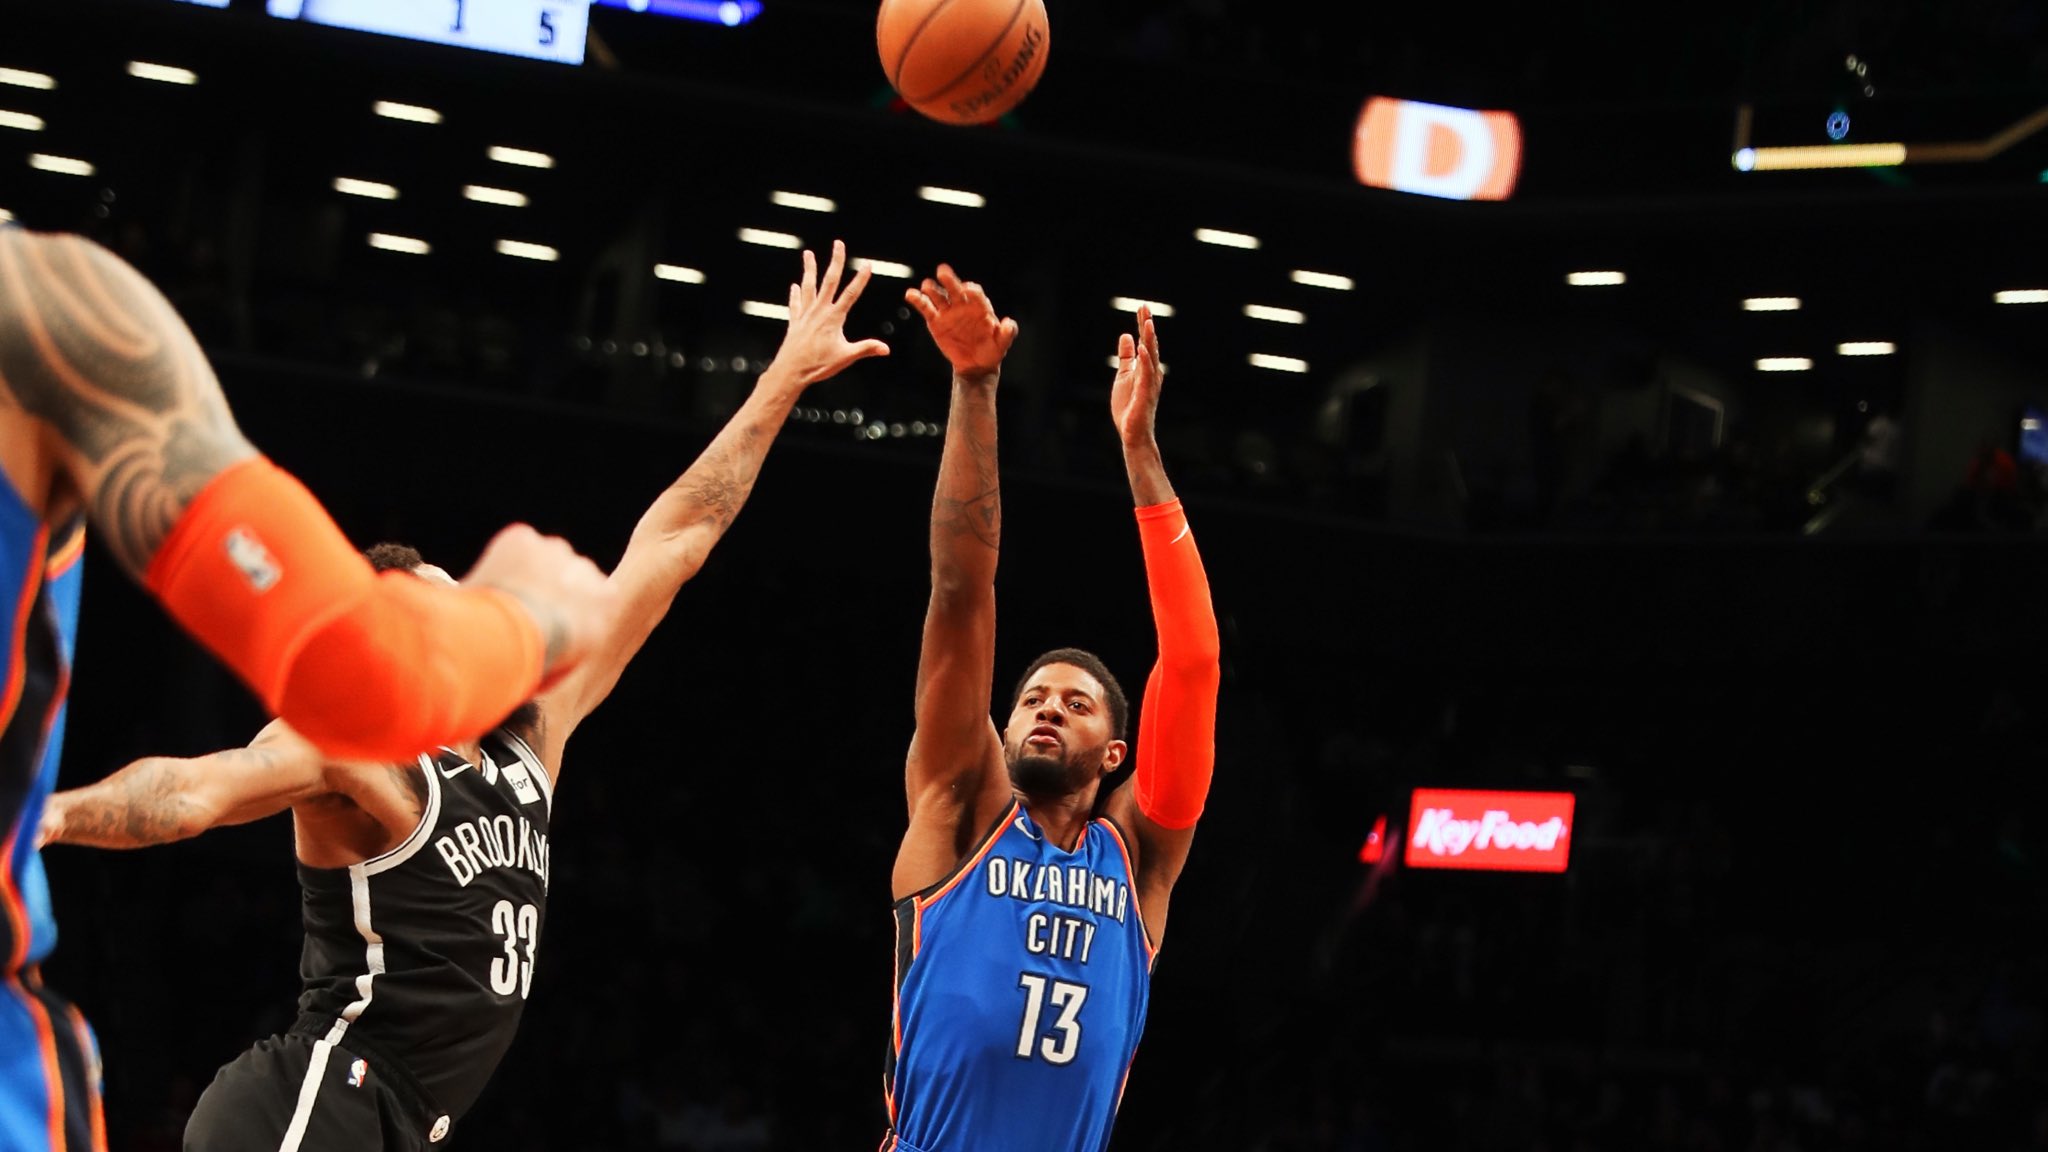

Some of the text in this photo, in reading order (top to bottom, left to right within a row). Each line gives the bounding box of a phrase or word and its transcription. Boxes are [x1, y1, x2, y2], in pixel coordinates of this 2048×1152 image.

[538, 10, 555, 45] 5
[1391, 99, 1497, 201] D
[489, 899, 539, 1001] 33
[1026, 912, 1096, 965] CITY
[1015, 972, 1088, 1065] 13
